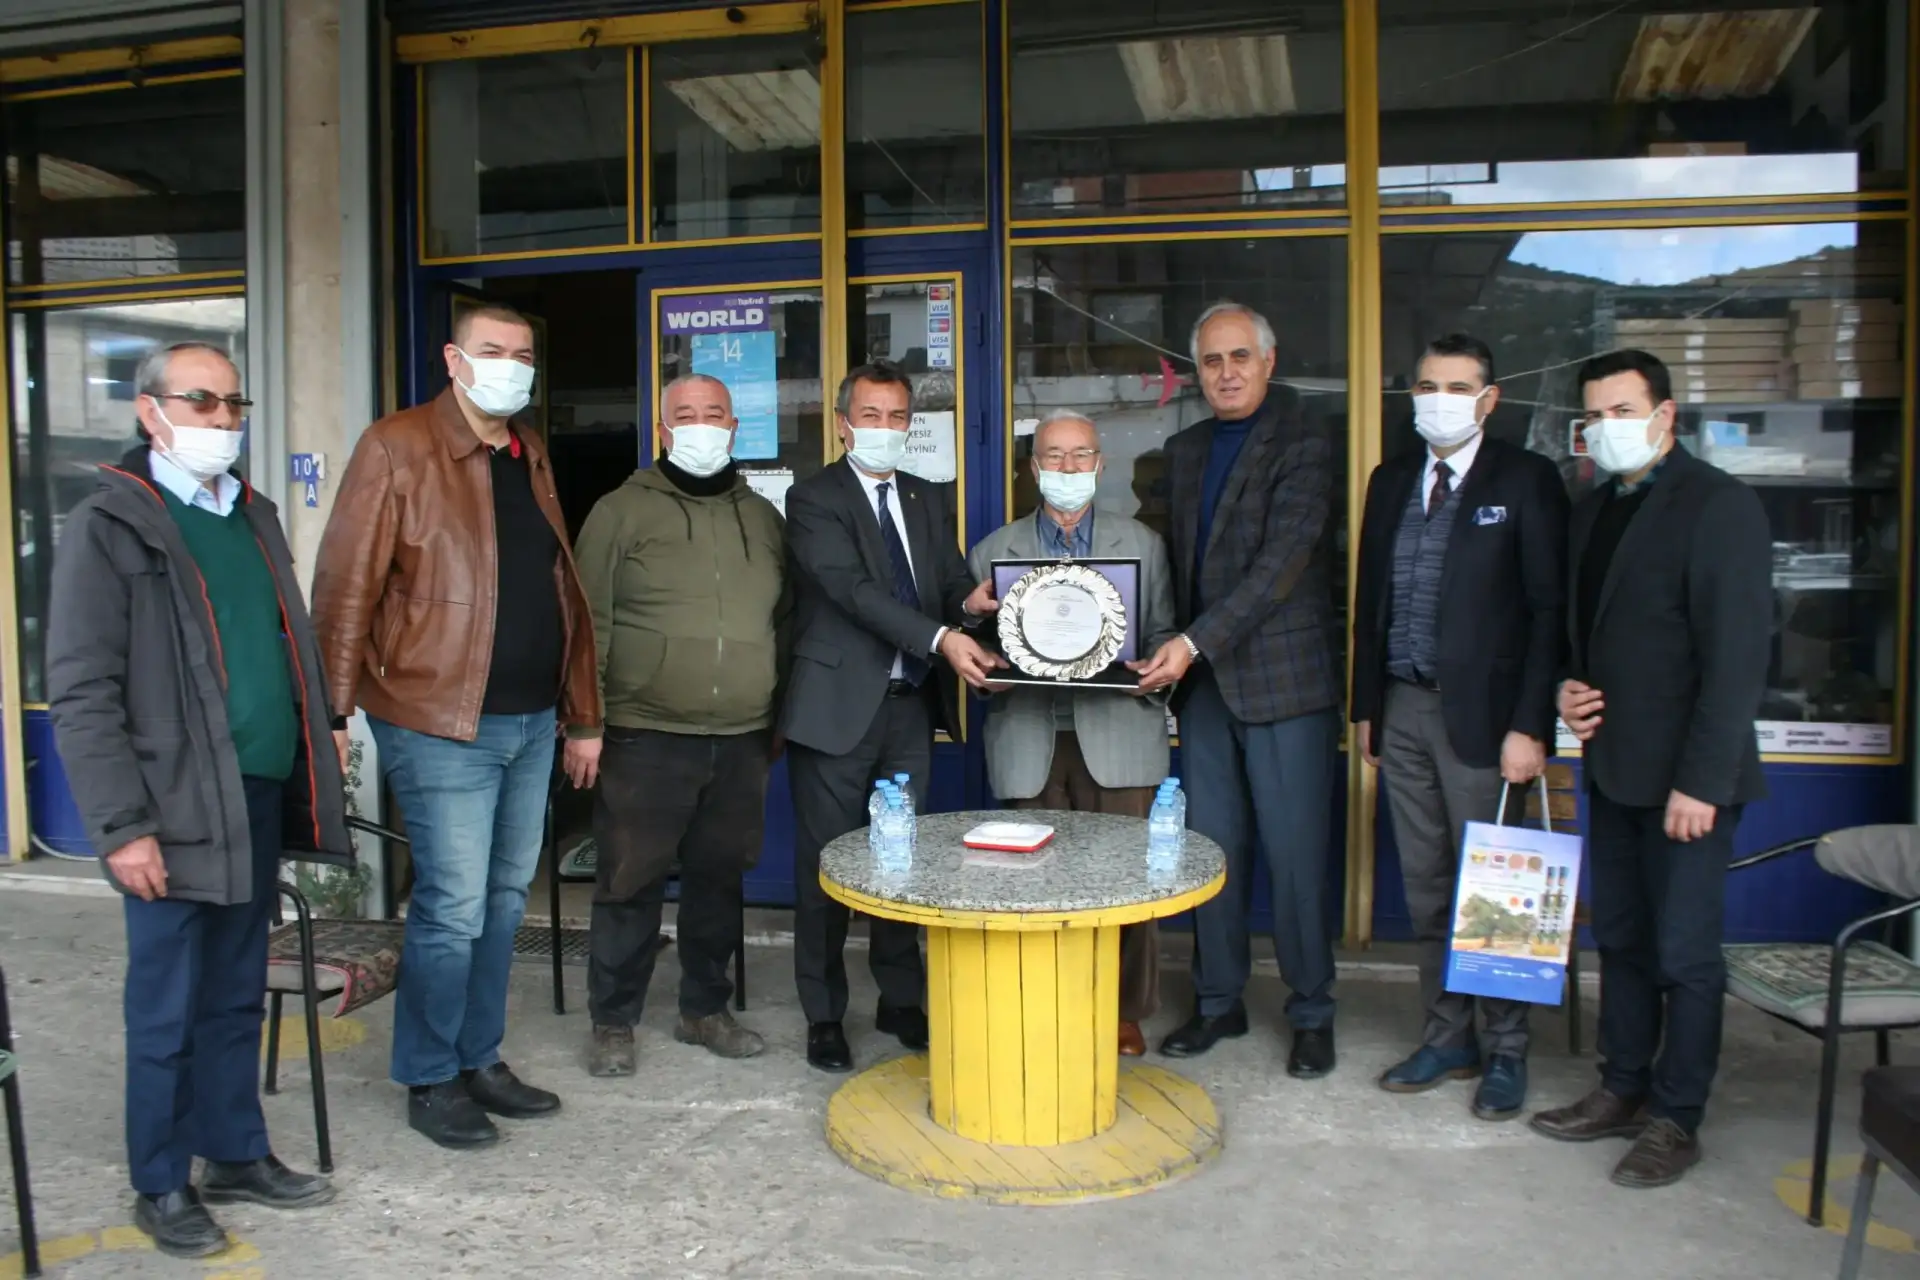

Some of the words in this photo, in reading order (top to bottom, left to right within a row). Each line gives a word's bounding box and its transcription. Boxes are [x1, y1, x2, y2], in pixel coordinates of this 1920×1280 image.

[931, 304, 949, 312] VISA
[667, 308, 764, 329] WORLD
[719, 338, 744, 363] 14
[913, 416, 926, 425] EN
[908, 428, 932, 438] KESİZ
[905, 444, 937, 454] EYİNİZ
[307, 483, 317, 502] A
